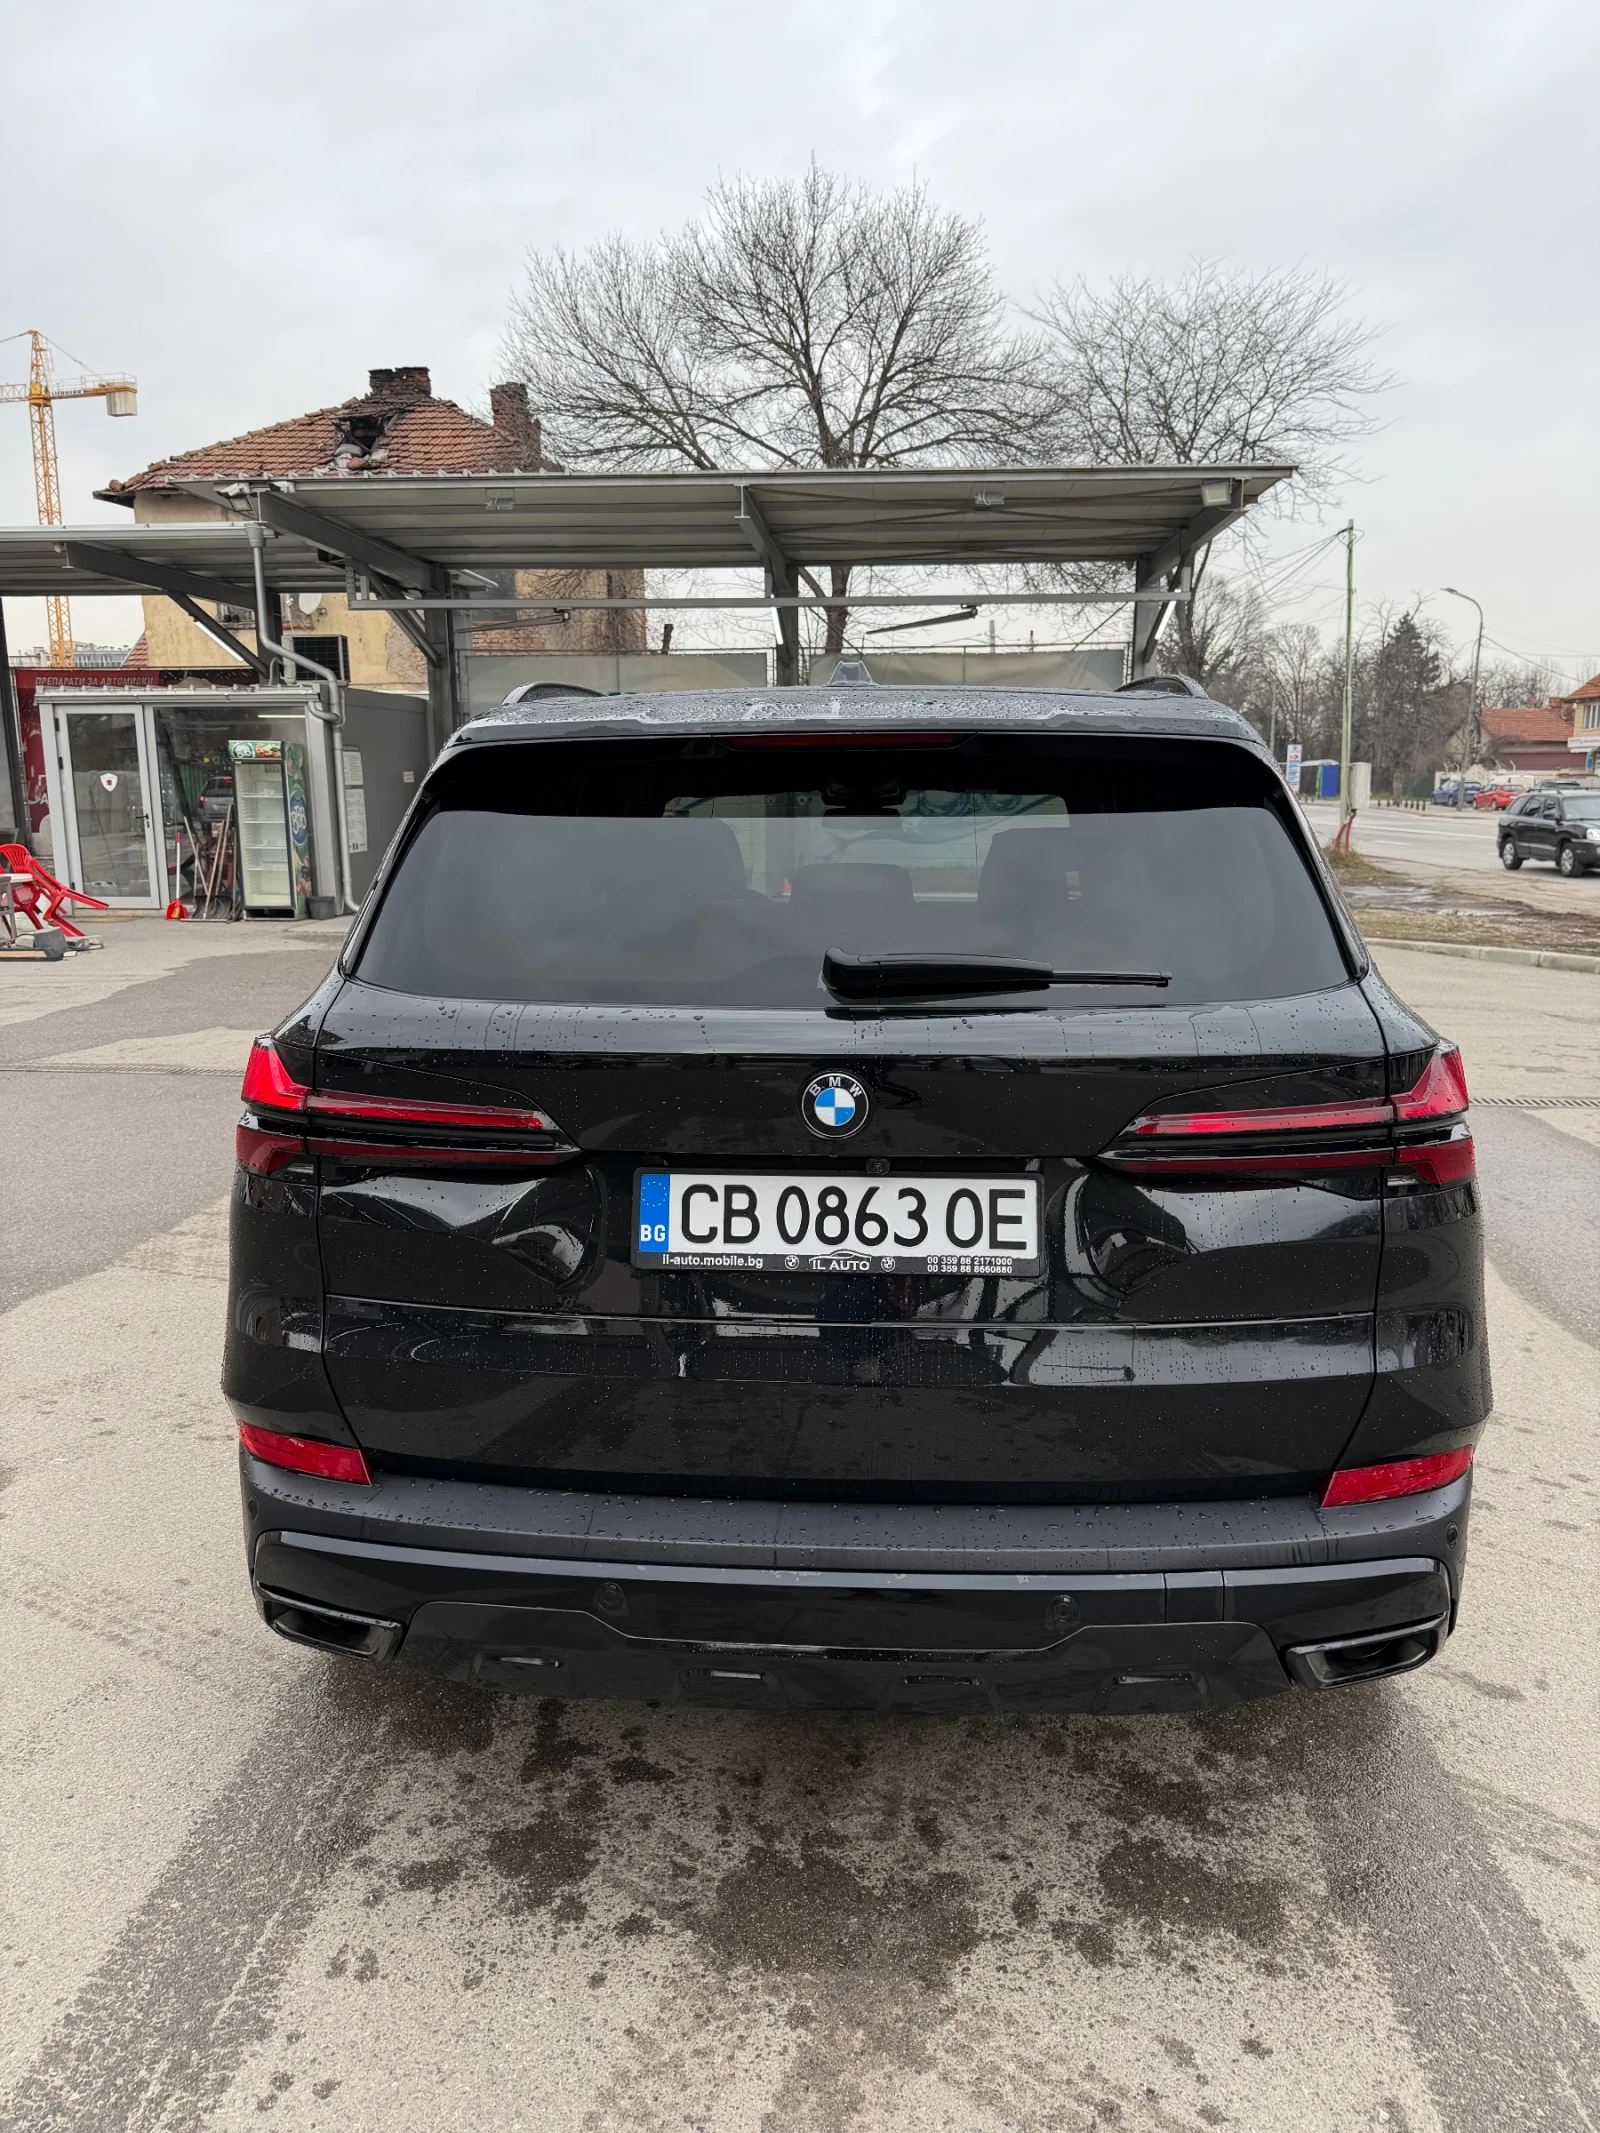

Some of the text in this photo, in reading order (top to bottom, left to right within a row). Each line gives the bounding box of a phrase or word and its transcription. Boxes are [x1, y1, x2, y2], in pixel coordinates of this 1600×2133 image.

[35, 676, 154, 685] ПРЕПАРАТИ ЗА АВТОМИВКИ
[809, 1076, 862, 1098] BMW
[681, 1184, 760, 1244] CB
[776, 1186, 928, 1247] 0863
[640, 1224, 666, 1242] BG
[662, 1254, 764, 1269] il-auto.mobile.bg
[812, 1260, 870, 1271] IL AUTO
[927, 1256, 1012, 1266] 00 359 88 2171000
[927, 1264, 939, 1272] 00
[940, 1264, 958, 1272] 359
[960, 1265, 971, 1273] 88
